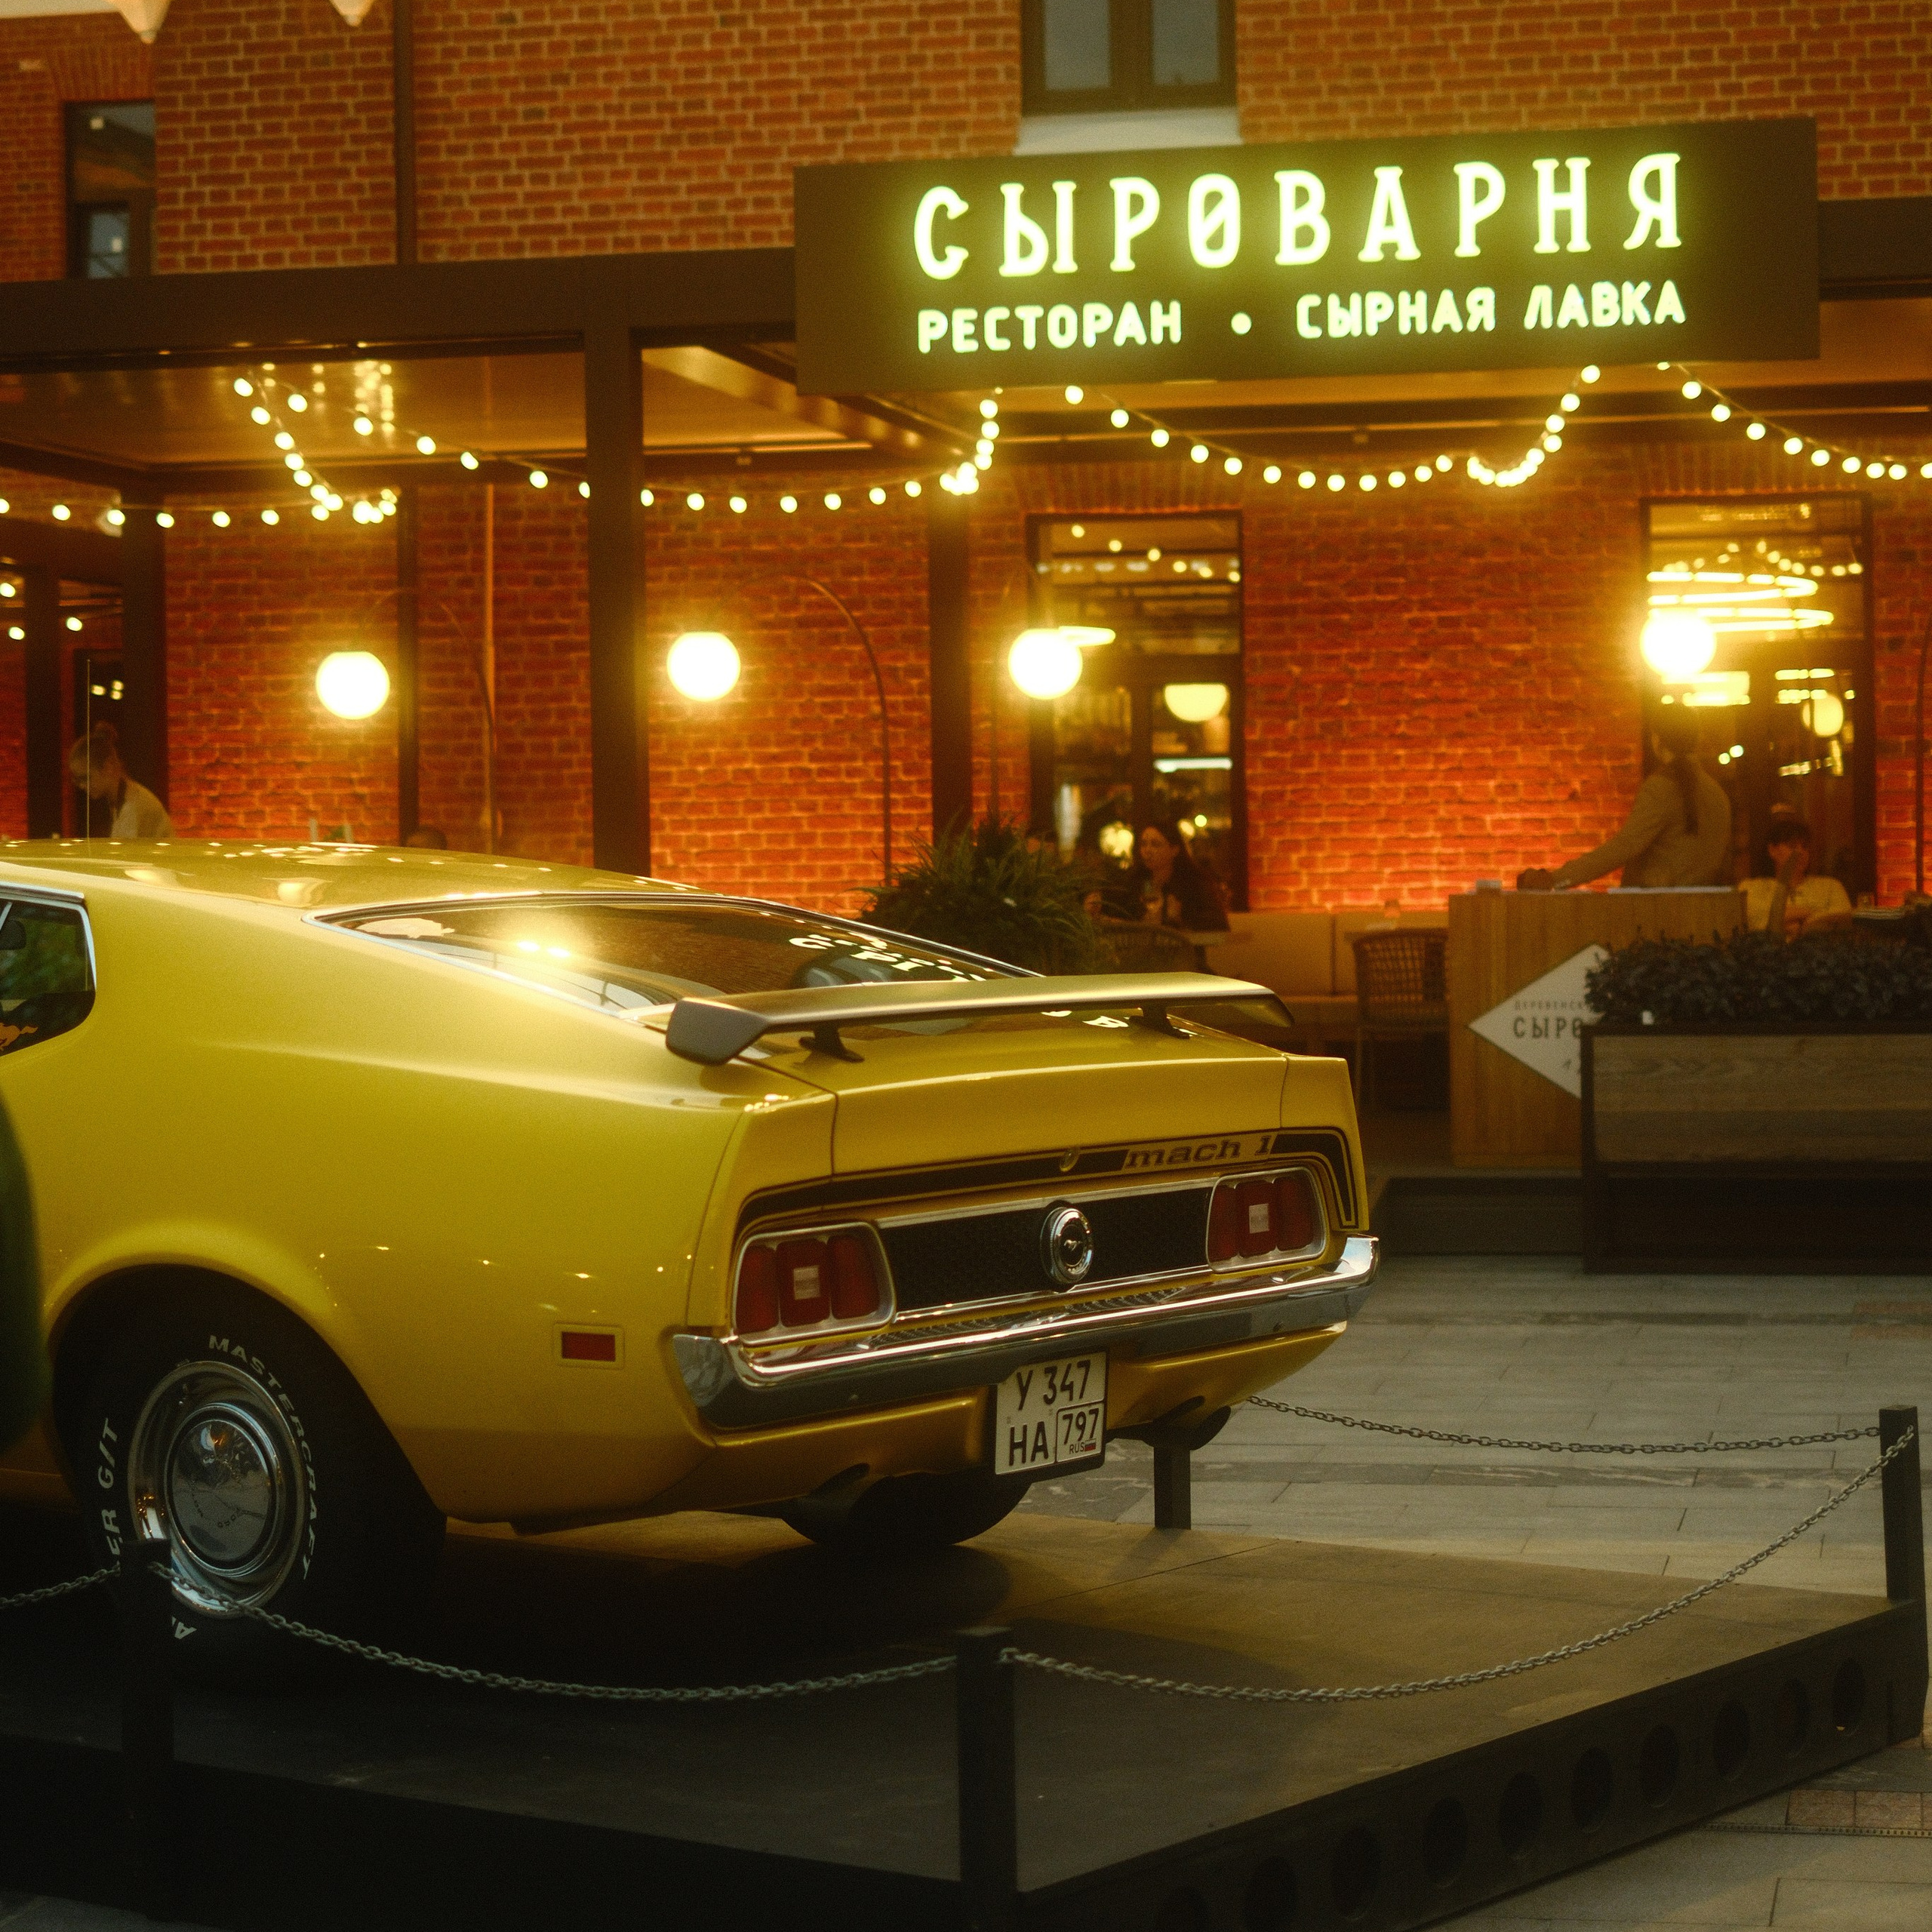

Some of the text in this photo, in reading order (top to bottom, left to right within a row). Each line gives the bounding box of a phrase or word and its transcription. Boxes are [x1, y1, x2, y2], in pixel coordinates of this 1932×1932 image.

[913, 152, 1683, 281] СЫРОВАРНЯ
[917, 279, 1687, 354] РЕСТОРАН СЫРНАЯ ЛАВКА
[1512, 1016, 1583, 1039] СЫРО
[1125, 1134, 1272, 1168] mach 1
[1043, 1359, 1091, 1405] 347
[209, 1334, 317, 1580] MASTERCRAFT
[1008, 1407, 1100, 1467] НА 797
[1069, 1441, 1085, 1455] RUS
